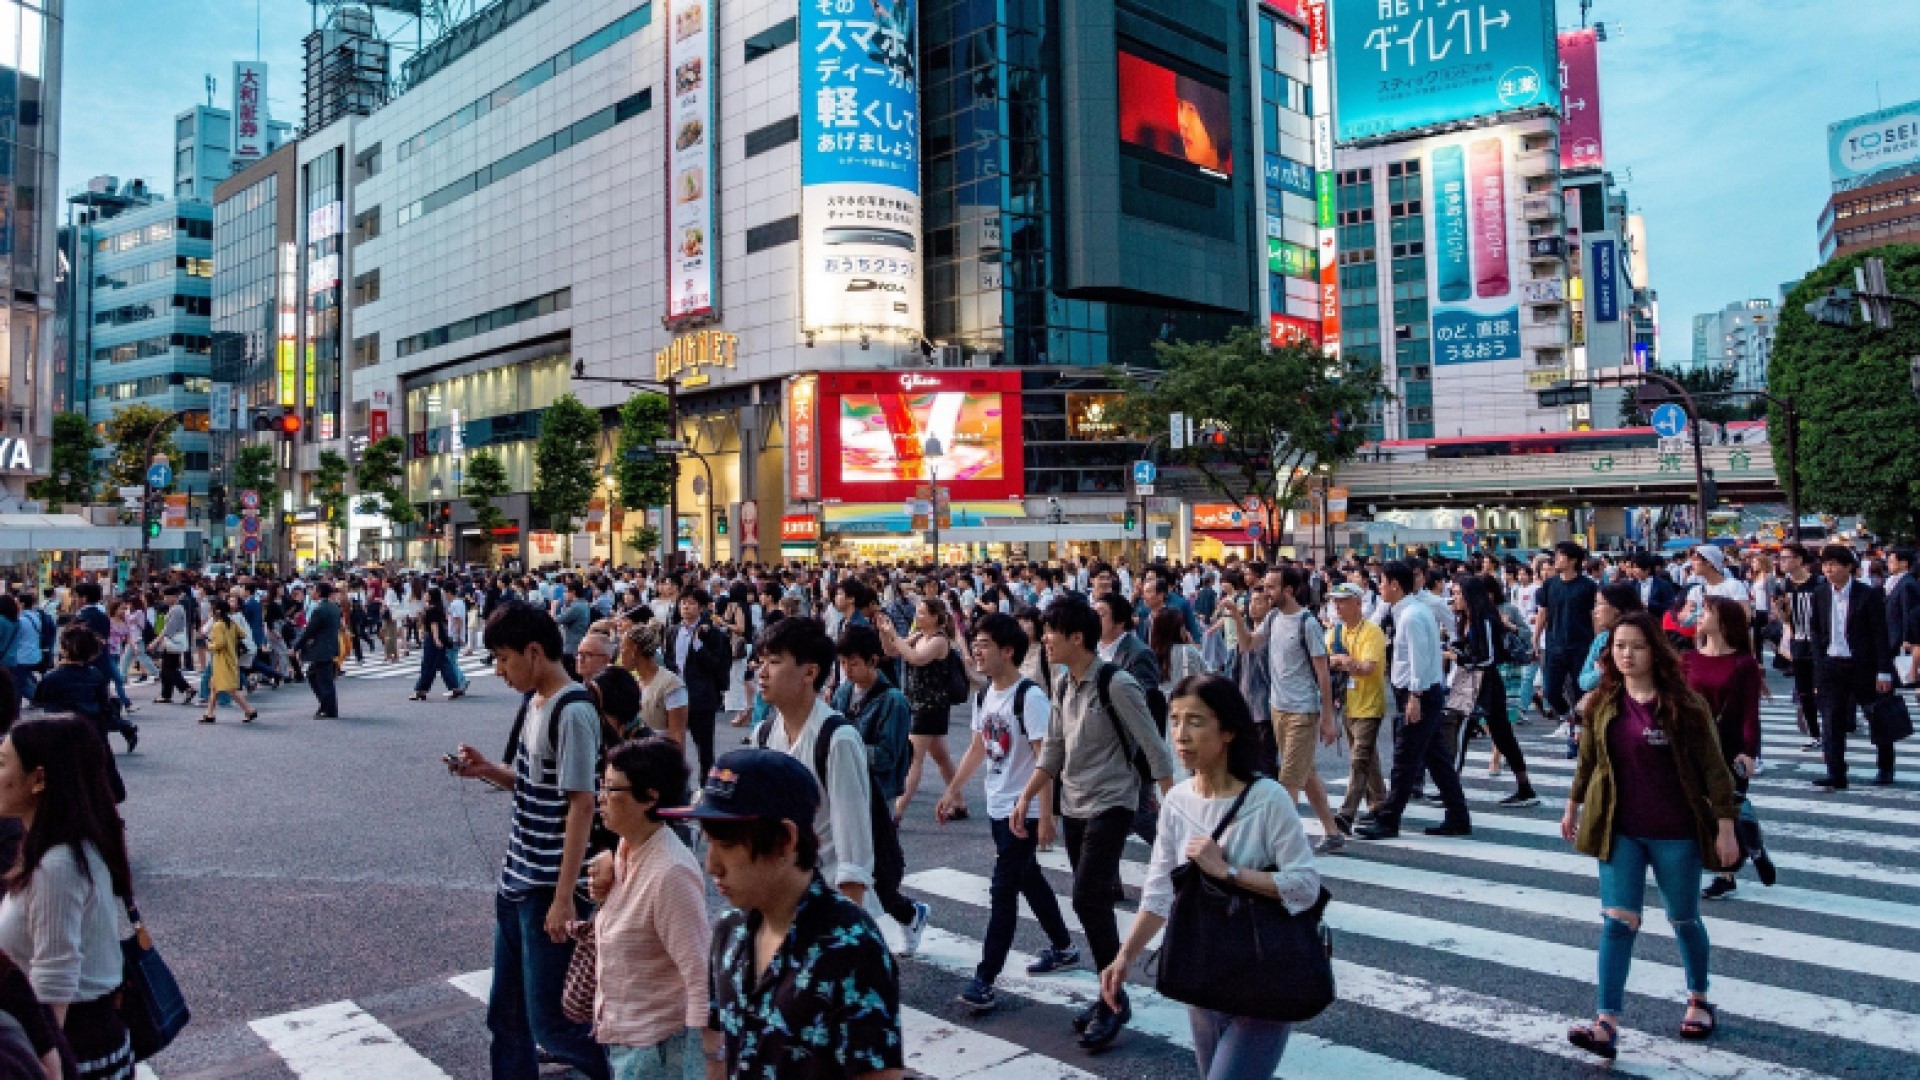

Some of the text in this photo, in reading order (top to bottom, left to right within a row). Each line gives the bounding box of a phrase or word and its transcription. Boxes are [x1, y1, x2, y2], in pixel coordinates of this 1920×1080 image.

[1363, 4, 1512, 72] ダイレクト
[816, 85, 915, 138] 軽くして
[1848, 121, 1918, 153] TOSEI
[1592, 455, 1615, 472] JR
